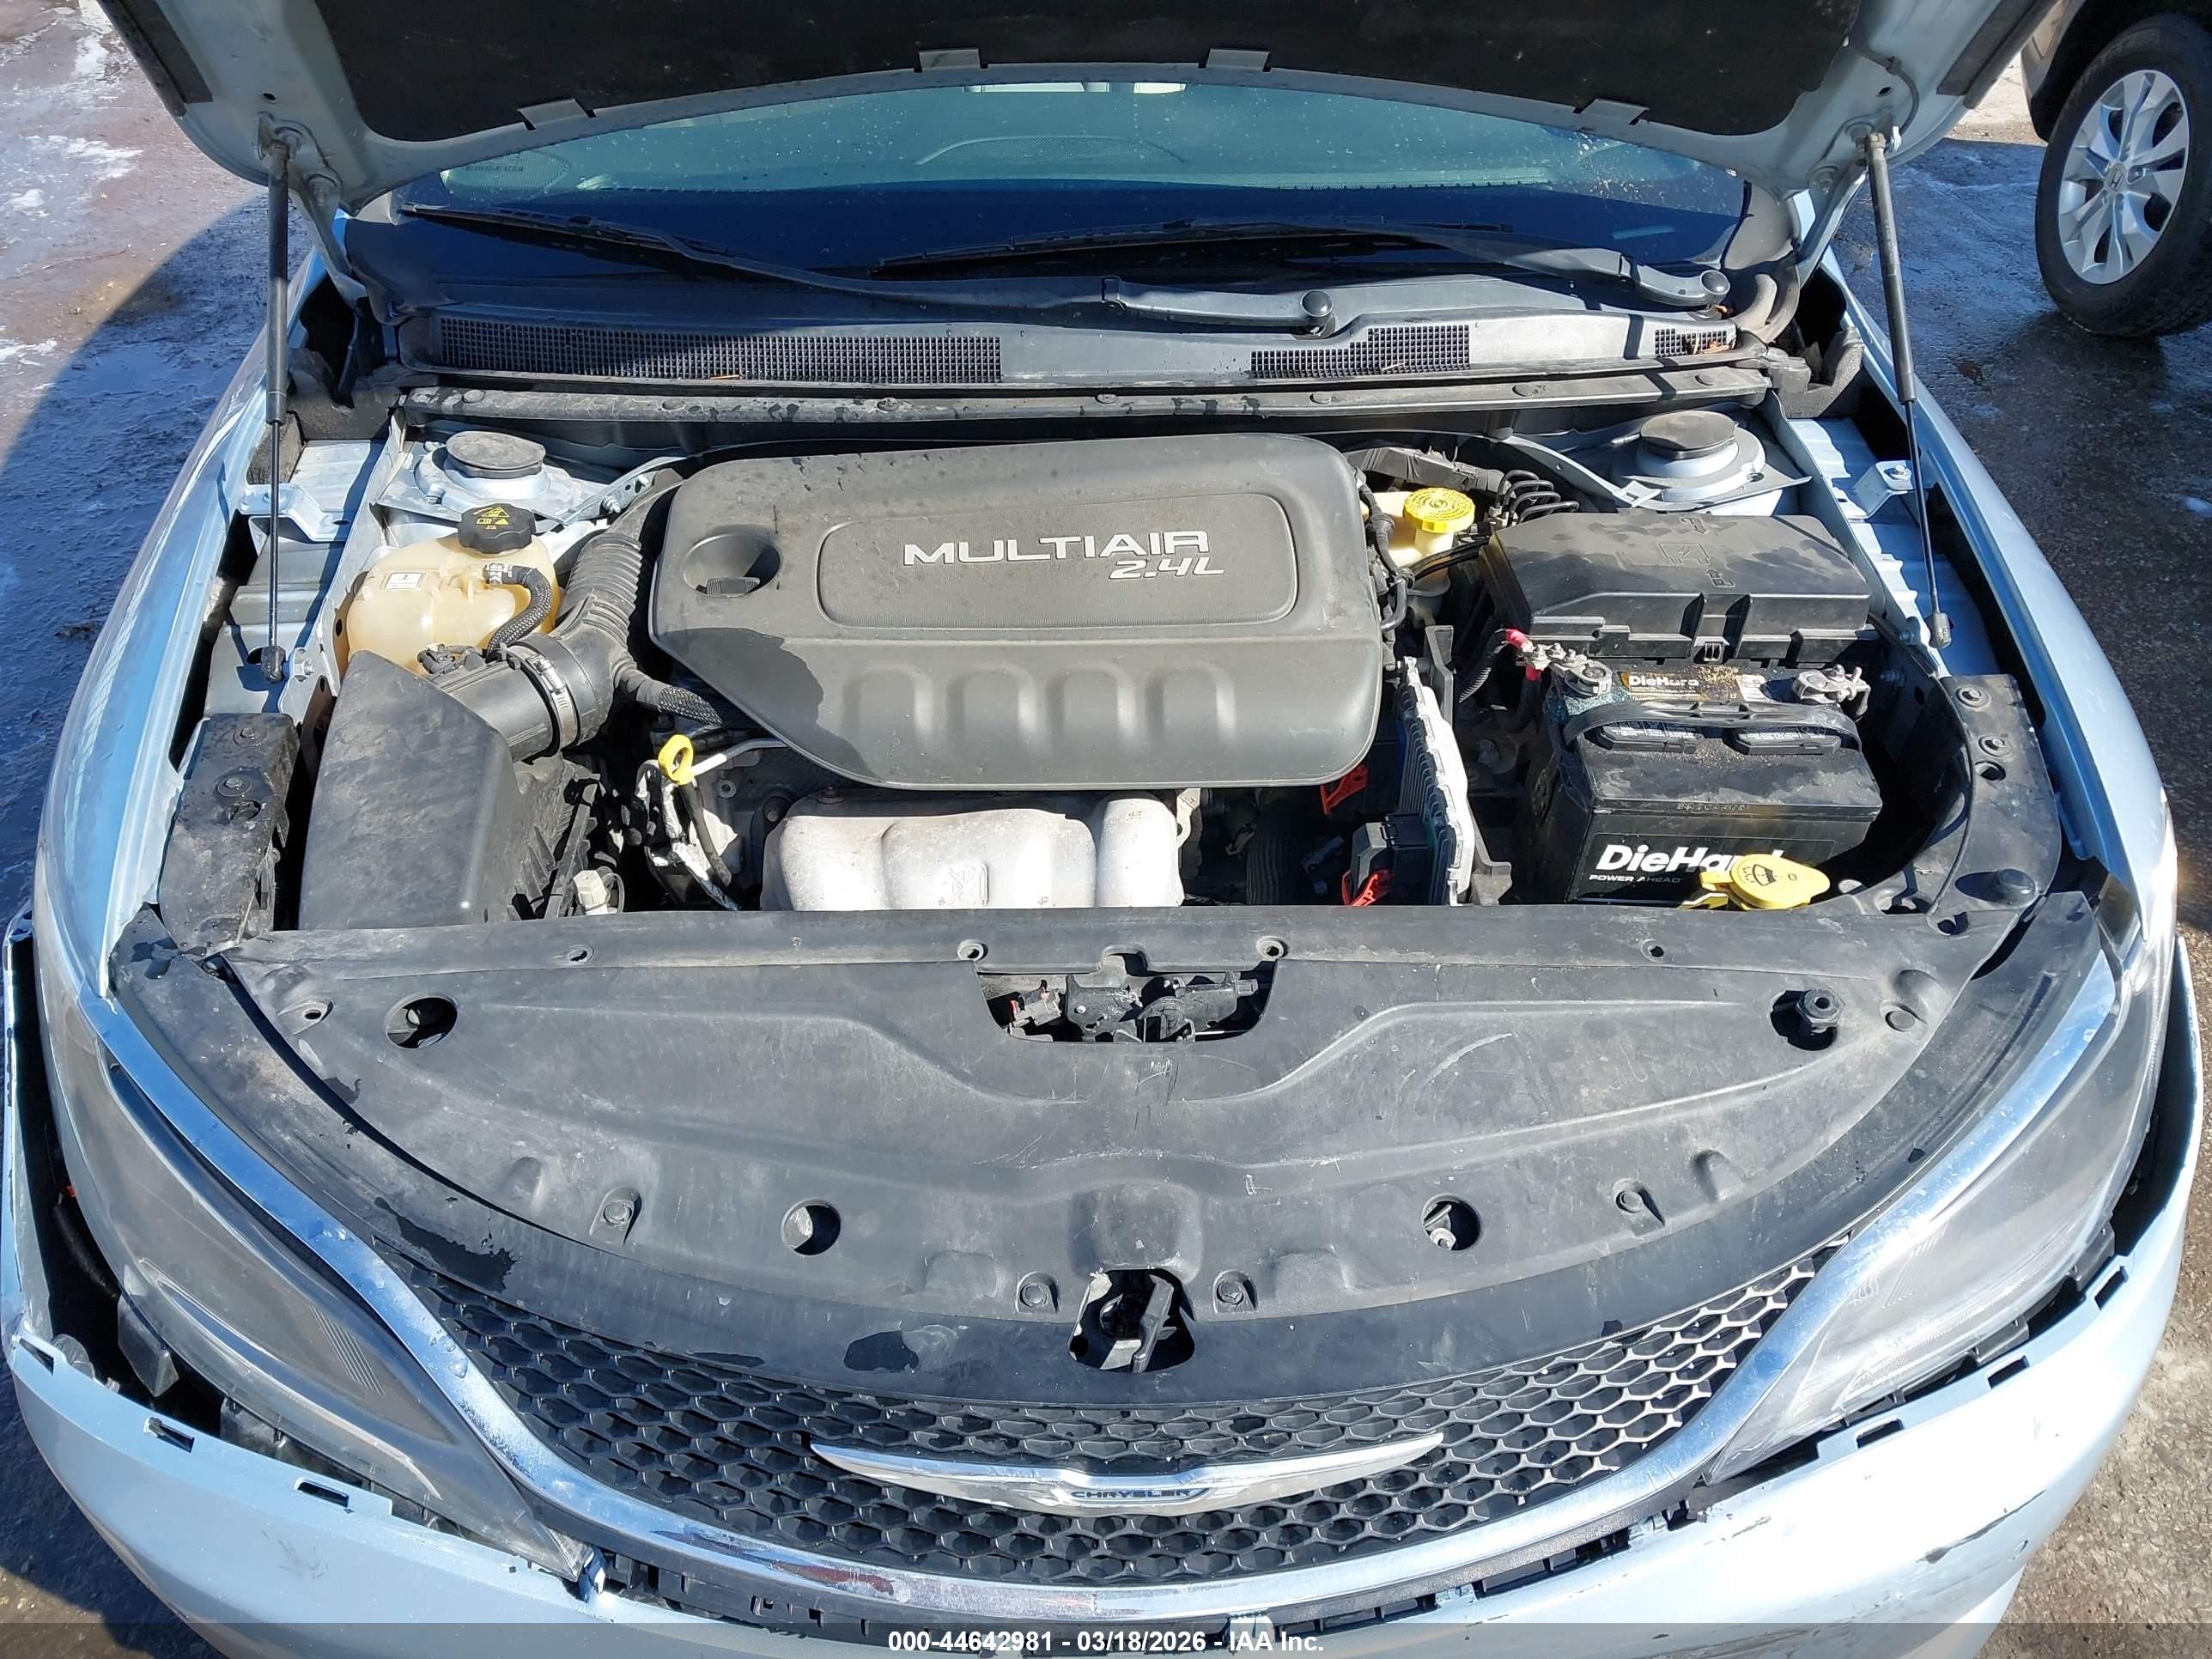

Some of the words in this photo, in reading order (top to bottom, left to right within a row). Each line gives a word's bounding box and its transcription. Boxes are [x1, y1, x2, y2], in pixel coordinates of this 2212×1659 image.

[902, 531, 1210, 566] MULTIAIR
[1108, 558, 1224, 580] 2.4L
[1595, 844, 1784, 872] DieHar
[1071, 1490, 1190, 1498] CHRYSLER
